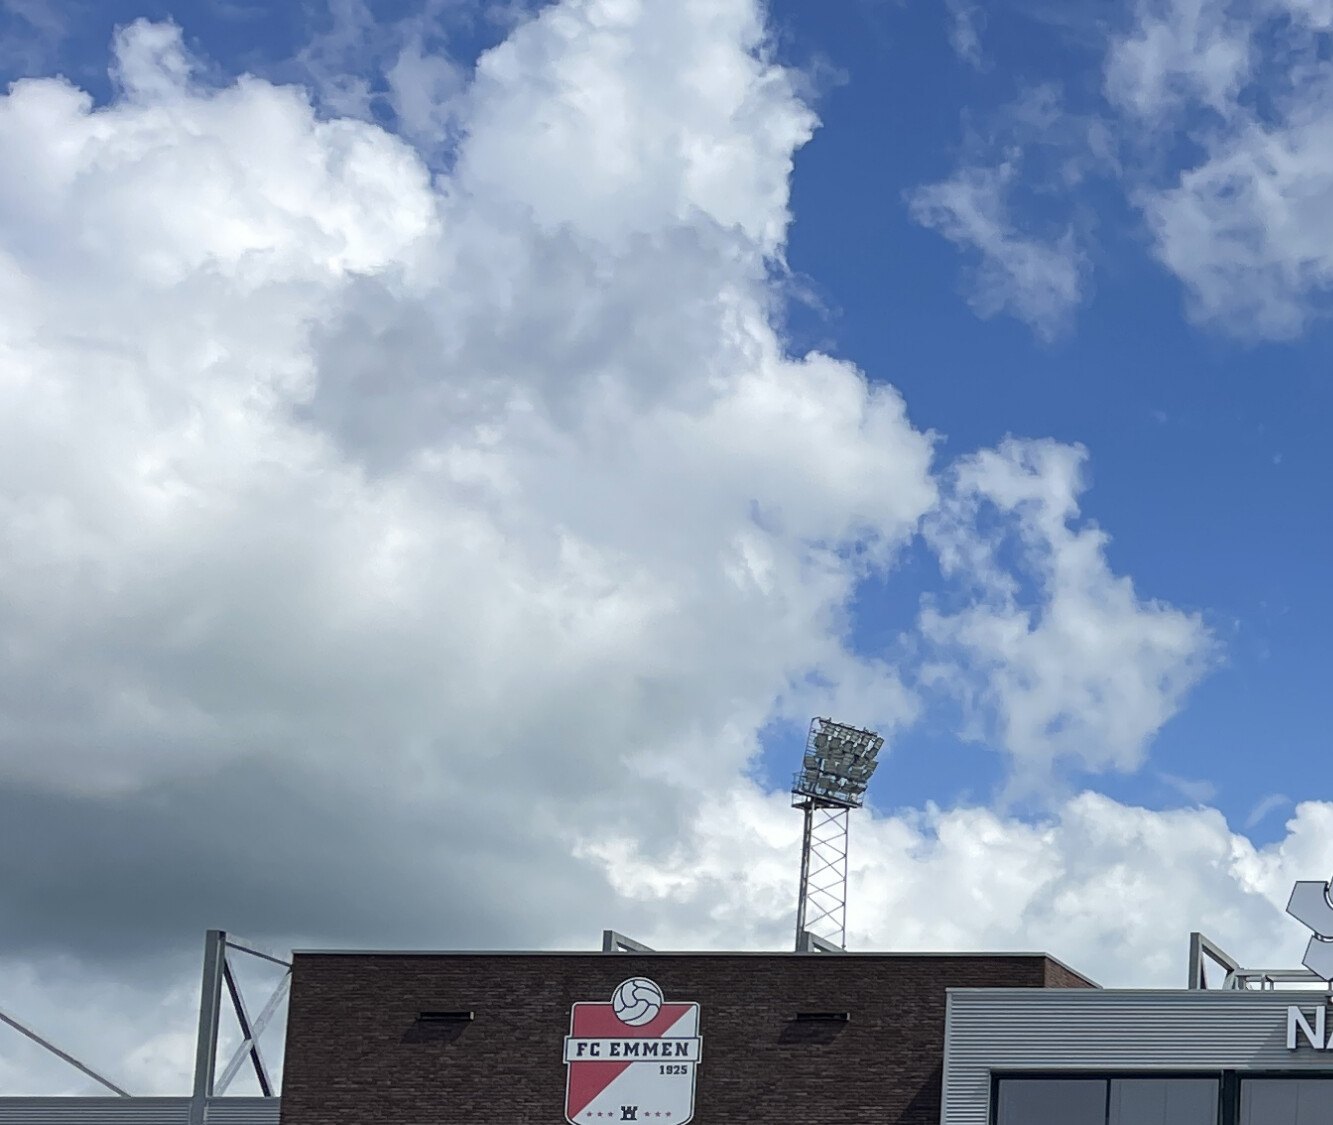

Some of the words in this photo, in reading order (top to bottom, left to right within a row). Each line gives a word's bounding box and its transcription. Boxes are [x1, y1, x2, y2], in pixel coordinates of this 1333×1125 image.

[576, 1042, 601, 1057] FC
[609, 1042, 690, 1057] EMMEN
[659, 1065, 688, 1075] 1925
